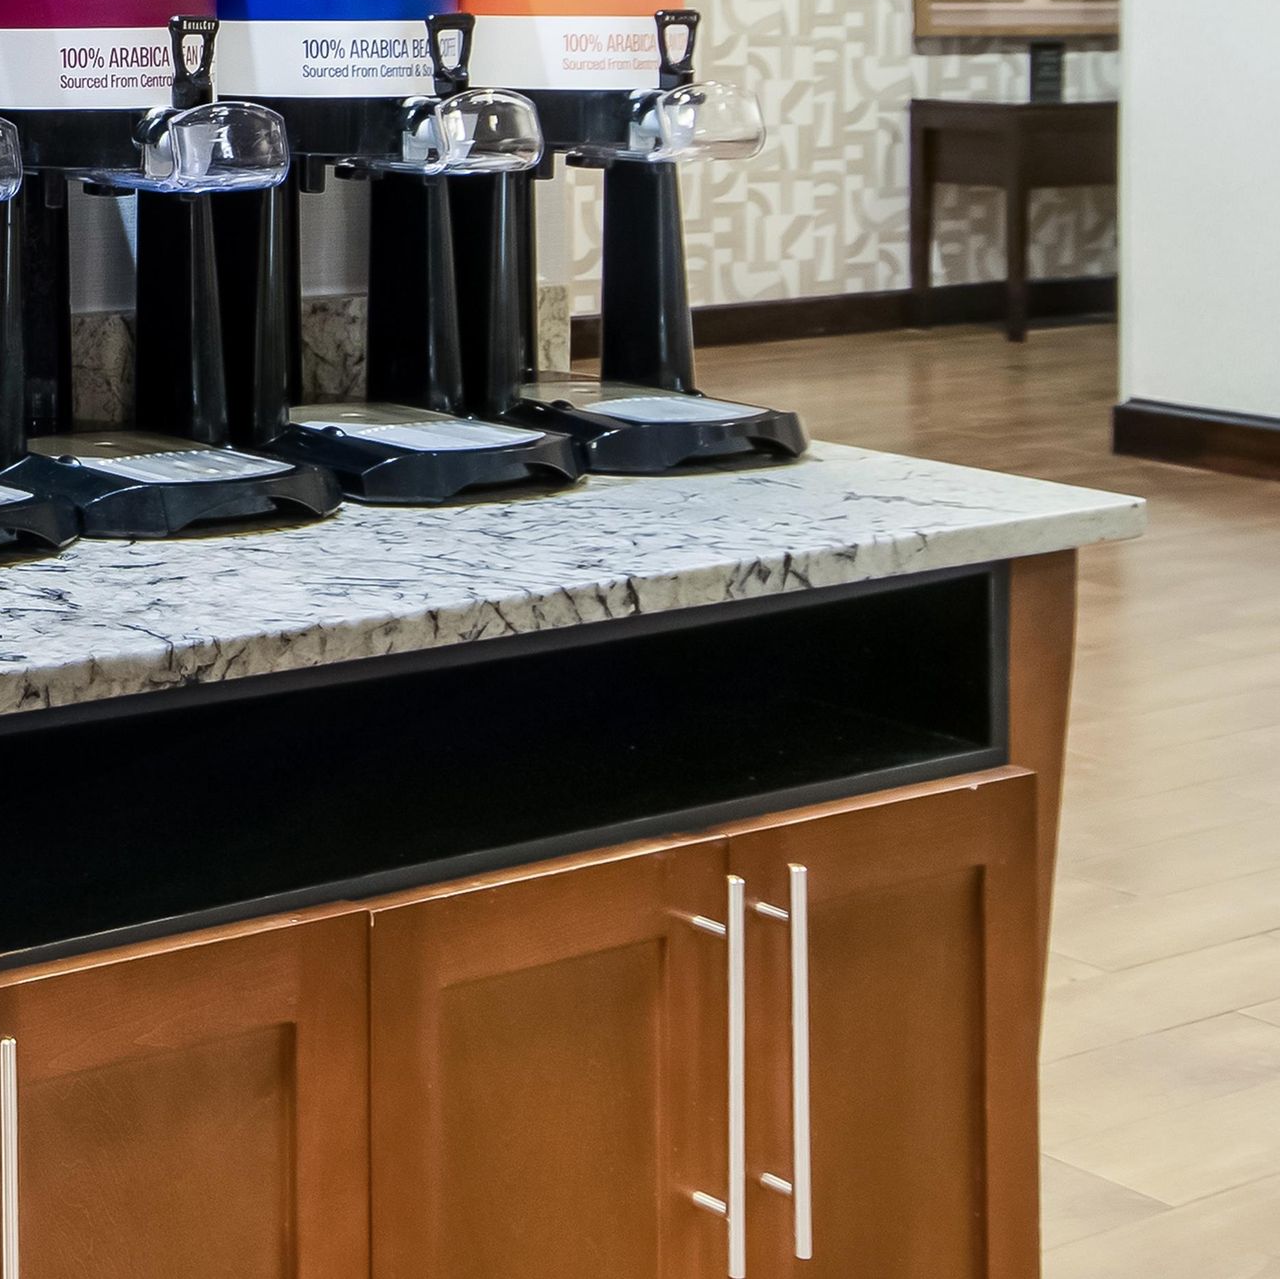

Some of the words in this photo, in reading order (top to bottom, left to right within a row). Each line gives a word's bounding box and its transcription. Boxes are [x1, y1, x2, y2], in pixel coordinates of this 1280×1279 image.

[302, 38, 346, 60] 100%
[349, 38, 409, 59] ARABICA
[562, 33, 603, 52] 100%
[606, 33, 657, 52] ARABICA
[59, 47, 105, 69] 100%
[108, 46, 170, 68] ARABICA
[302, 64, 349, 78] Sourced
[351, 64, 379, 78] From
[380, 64, 413, 78] Central
[60, 74, 108, 89] Sourced
[110, 74, 138, 88] From
